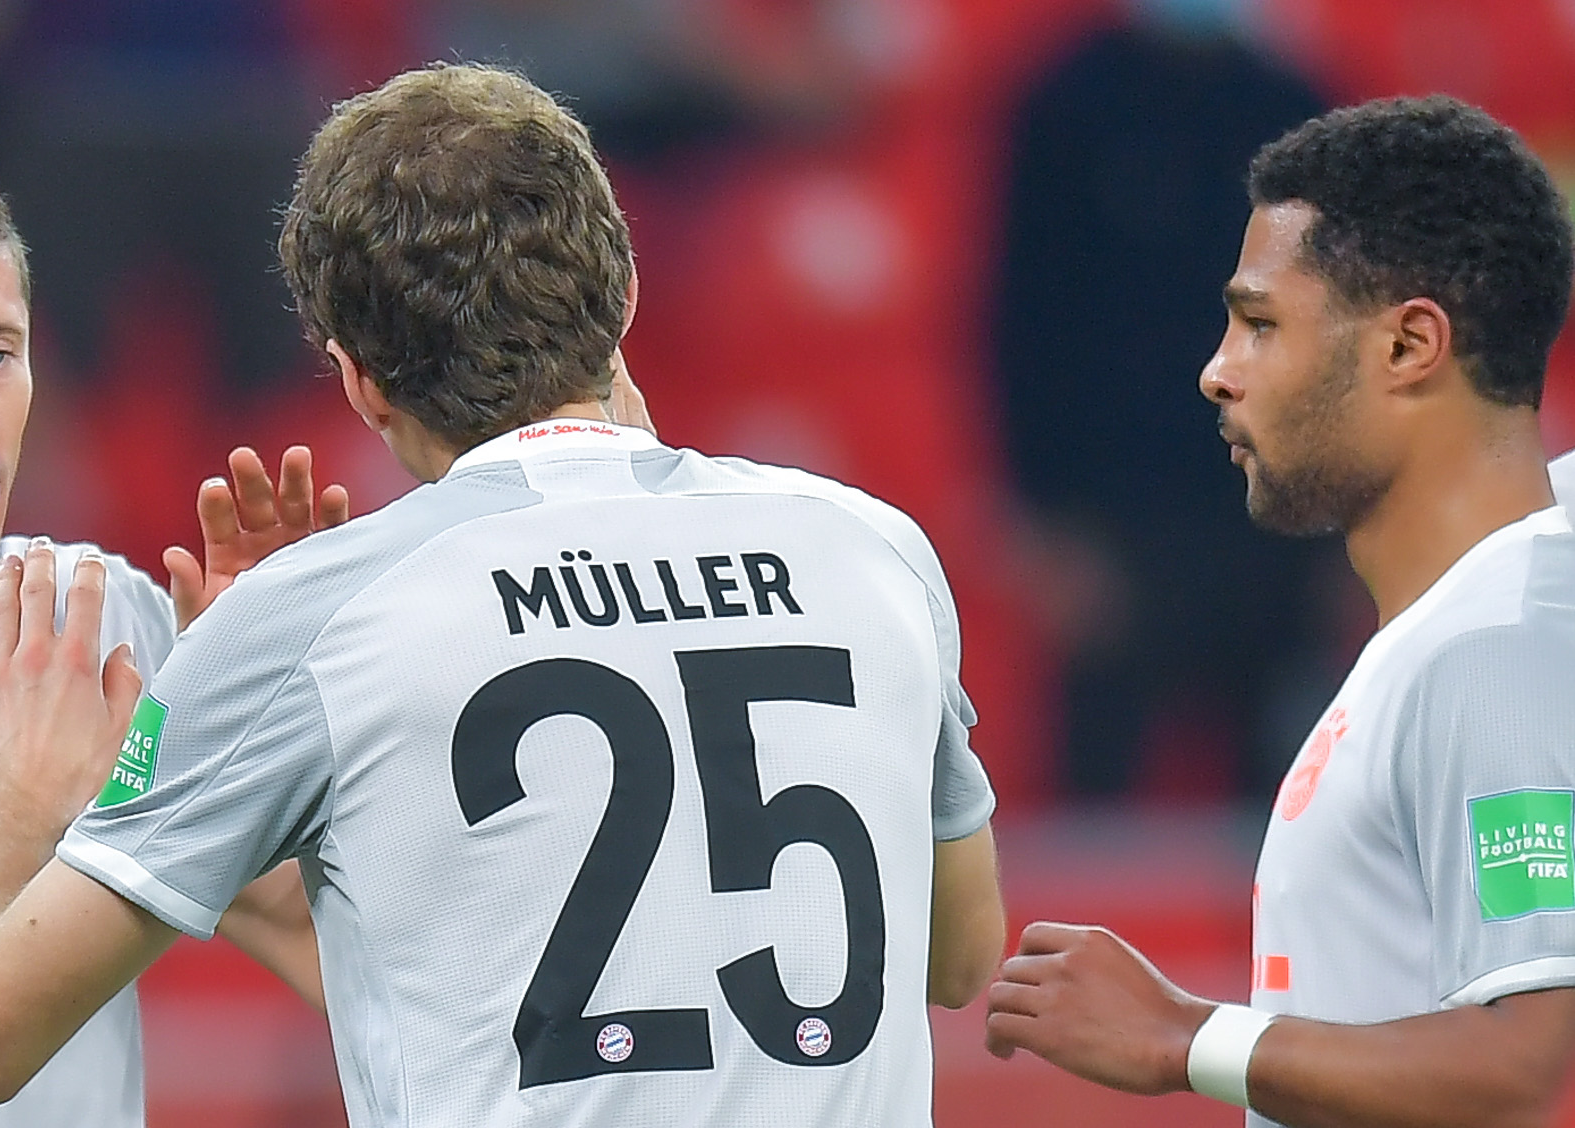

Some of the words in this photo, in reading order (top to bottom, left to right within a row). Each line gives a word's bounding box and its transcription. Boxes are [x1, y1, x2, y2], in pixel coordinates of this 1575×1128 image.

[519, 426, 550, 442] Mia
[590, 424, 620, 436] mia
[491, 549, 804, 635] MÜLLER
[128, 728, 153, 750] ING
[121, 739, 148, 764] BALL
[112, 765, 147, 792] FIFA
[1479, 823, 1565, 845] LIVING
[1480, 837, 1565, 859] FOOTBALL
[451, 645, 886, 1091] 25
[1528, 863, 1568, 879] FIFA
